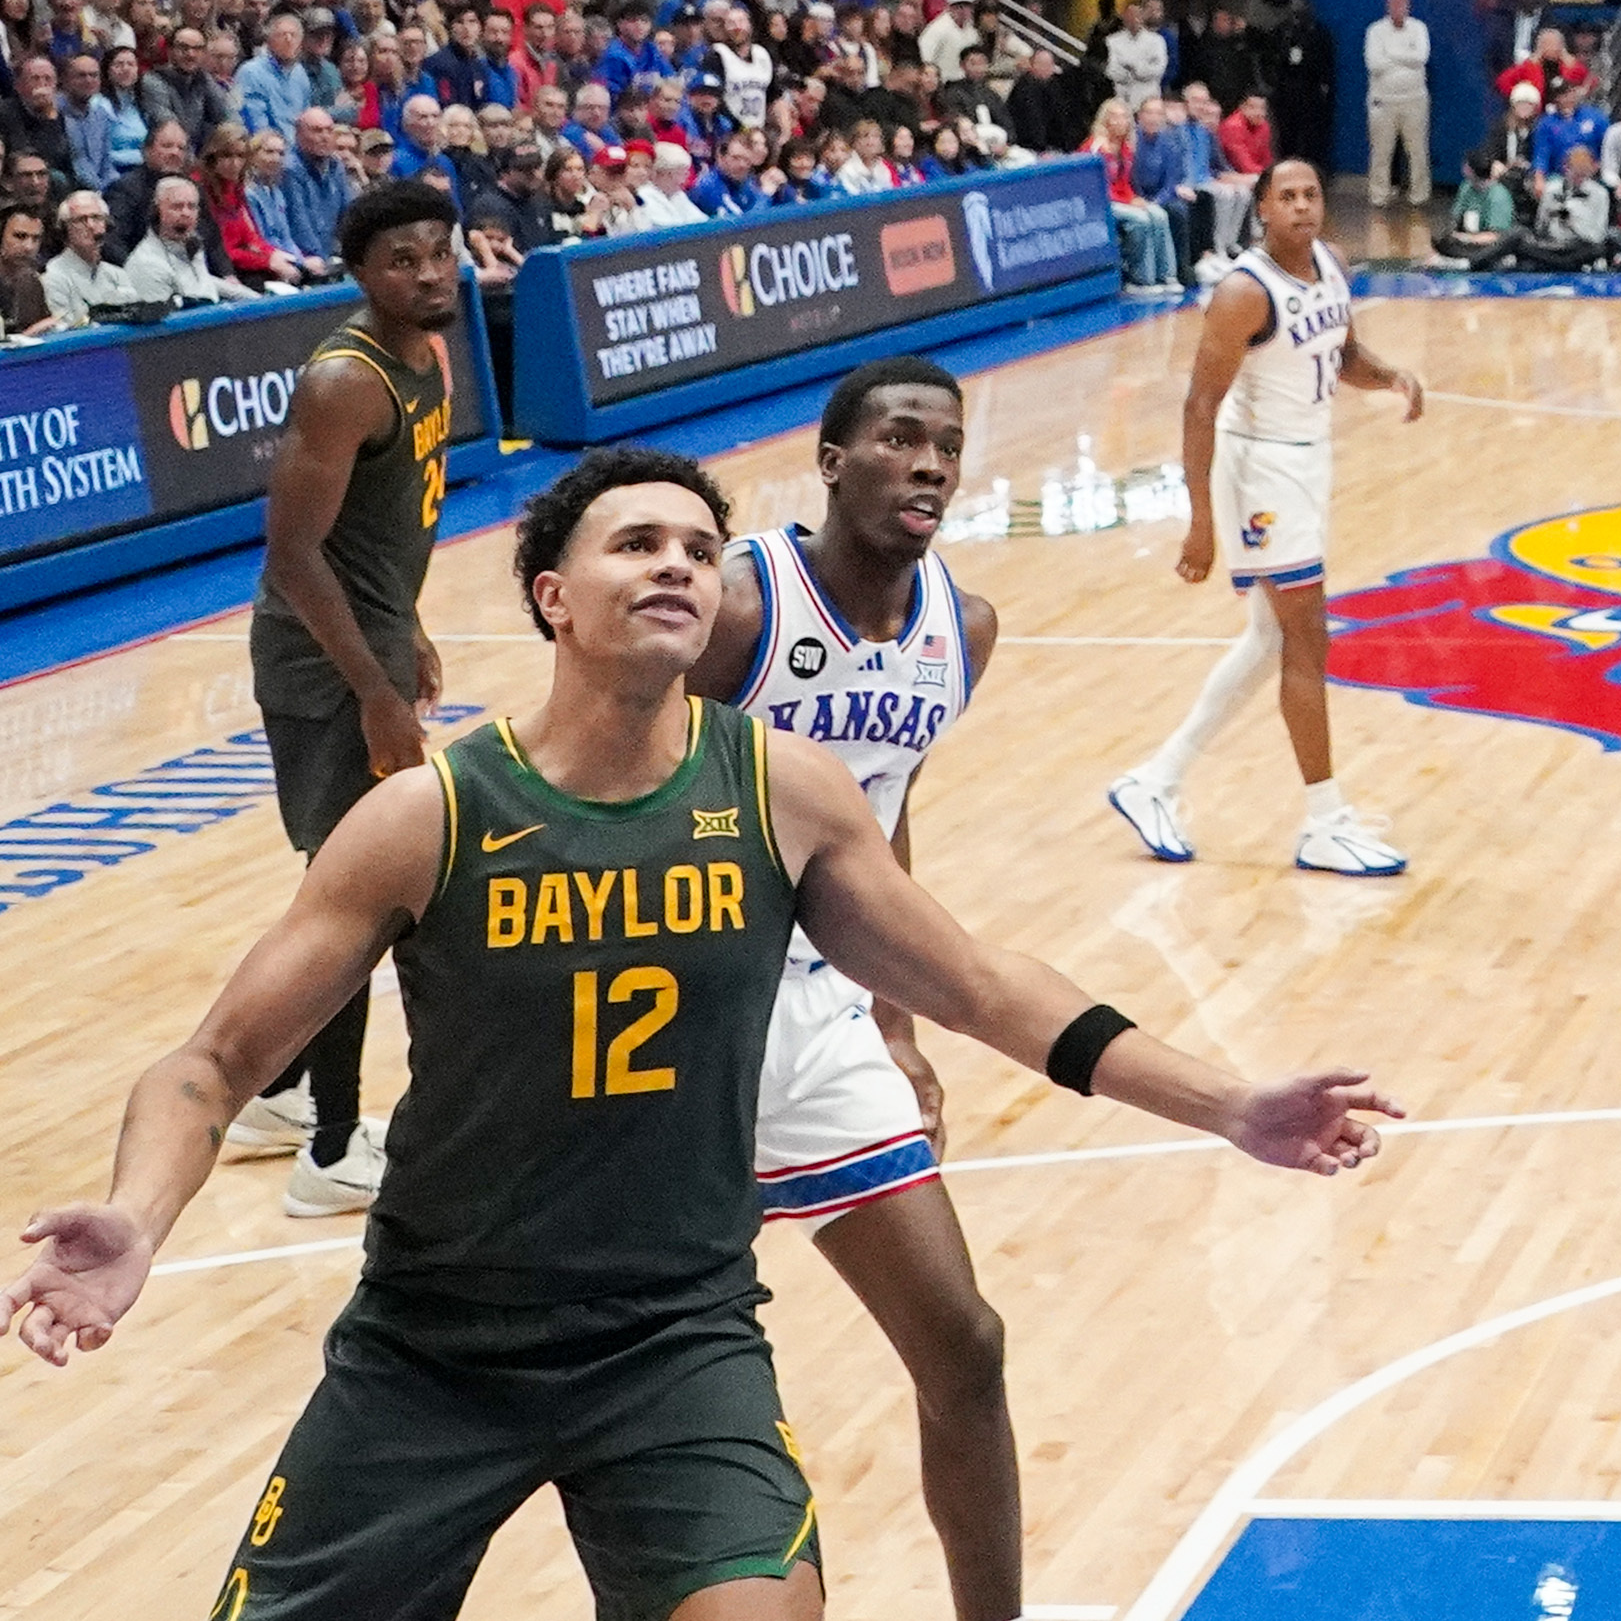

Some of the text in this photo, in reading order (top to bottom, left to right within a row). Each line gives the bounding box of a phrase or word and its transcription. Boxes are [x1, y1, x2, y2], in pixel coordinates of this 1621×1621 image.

[593, 258, 701, 308] WHERE FANS
[750, 233, 859, 307] CHOICE
[604, 293, 702, 342] STAY WHEN
[668, 322, 717, 362] AWAY
[0, 404, 81, 462] TY OF
[0, 444, 142, 516] TH SYSTEM
[792, 644, 824, 672] SW
[487, 861, 746, 949] BAYLOR
[571, 965, 680, 1099] 12
